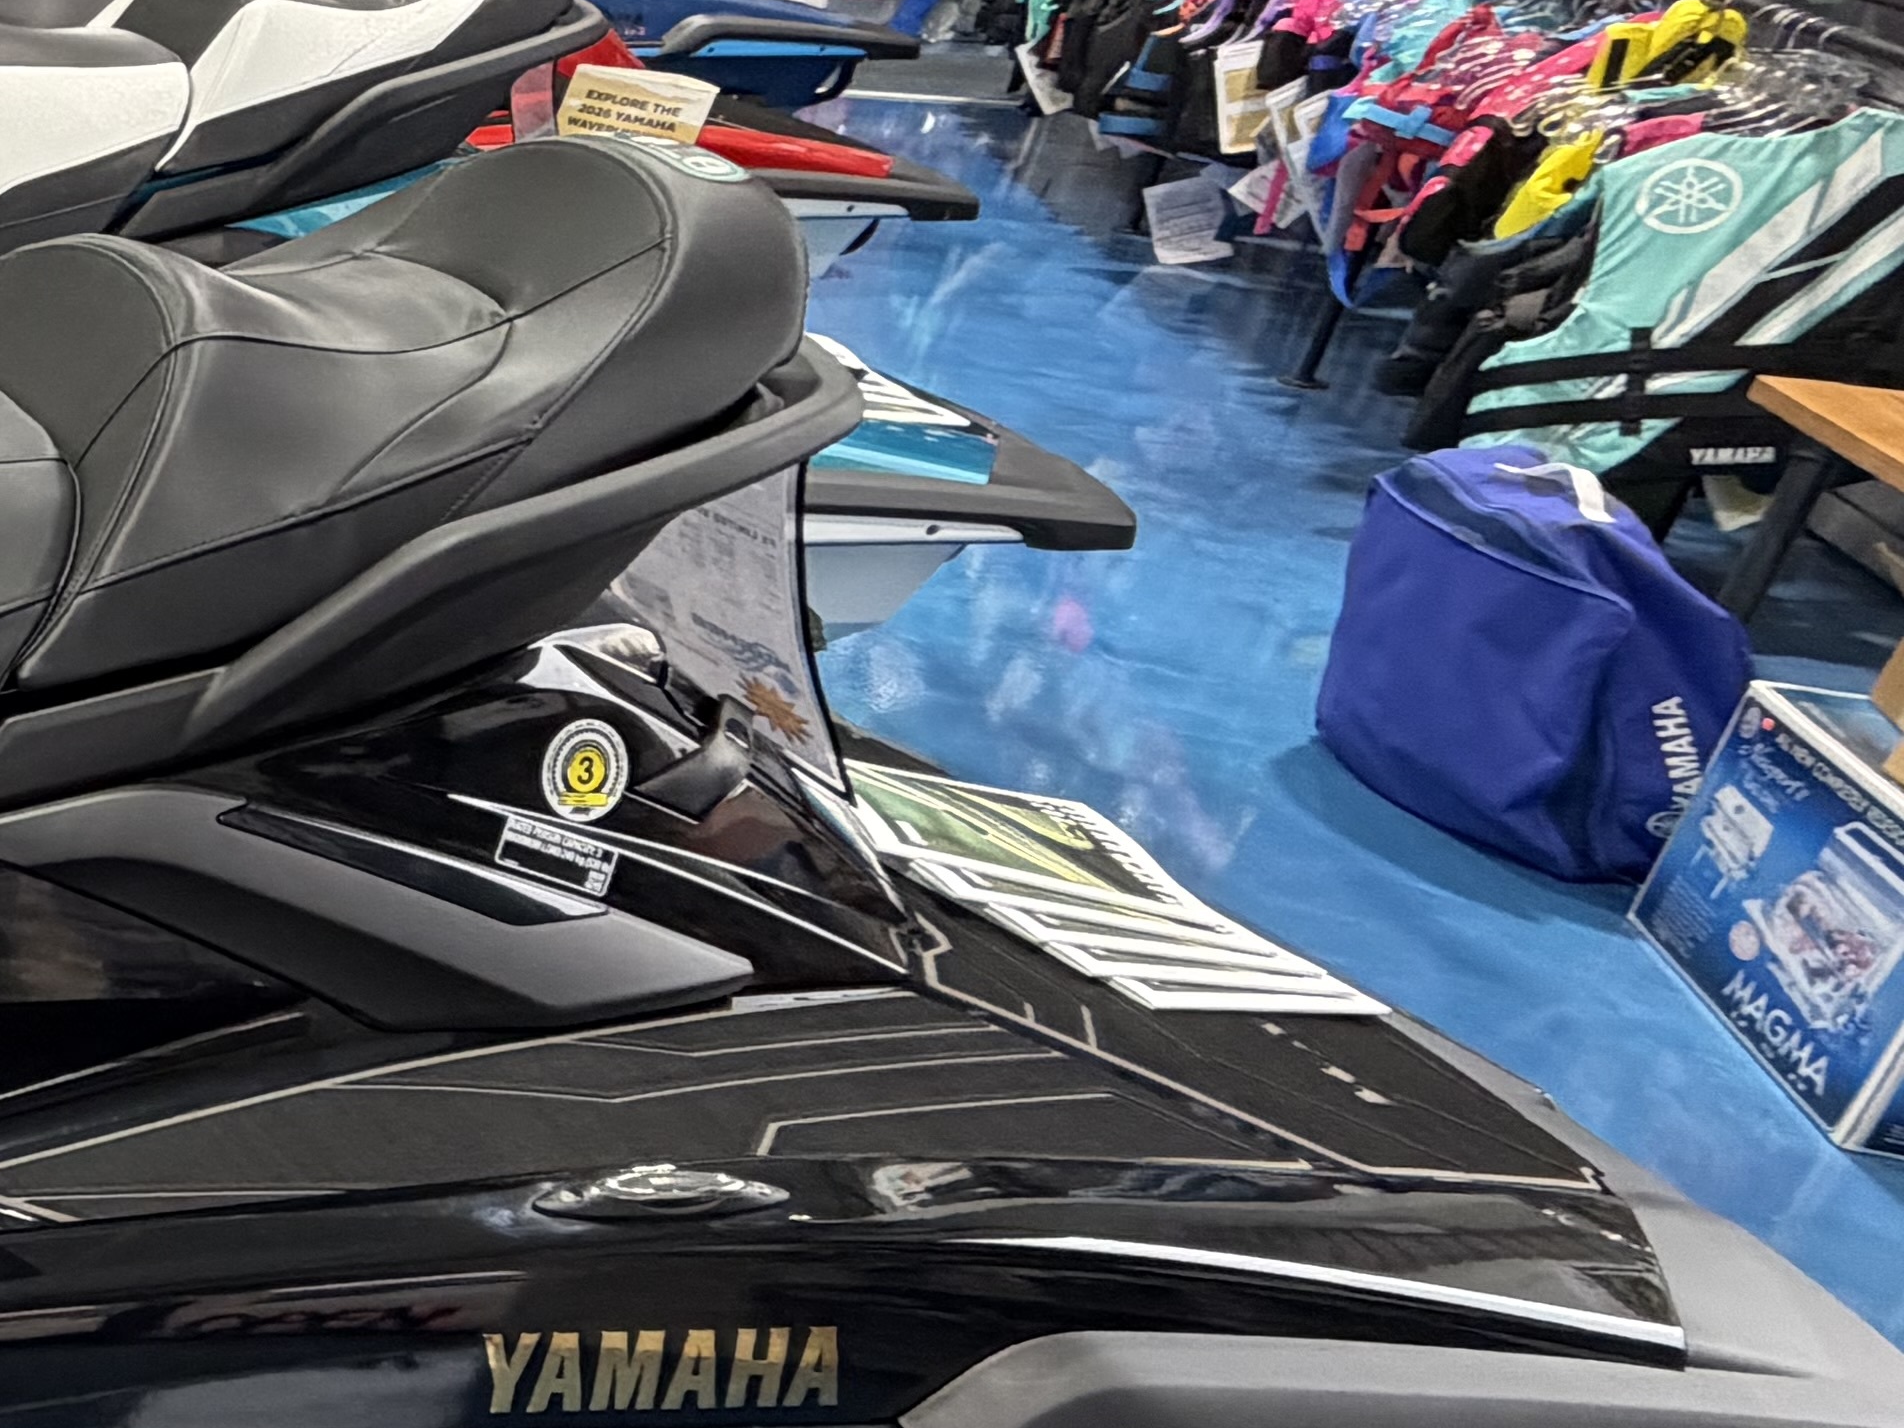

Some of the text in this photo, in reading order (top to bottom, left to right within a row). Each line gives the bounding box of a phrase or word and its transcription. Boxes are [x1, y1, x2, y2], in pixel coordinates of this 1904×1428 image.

[577, 103, 676, 132] 2026 YAMAHA
[585, 89, 684, 118] EXPLORE THE
[1690, 446, 1777, 466] YAMAHA
[1653, 696, 1701, 815] YAMAHA
[577, 756, 594, 785] 3
[1722, 970, 1830, 1098] MAGMA
[483, 1326, 839, 1414] YAMAHA
